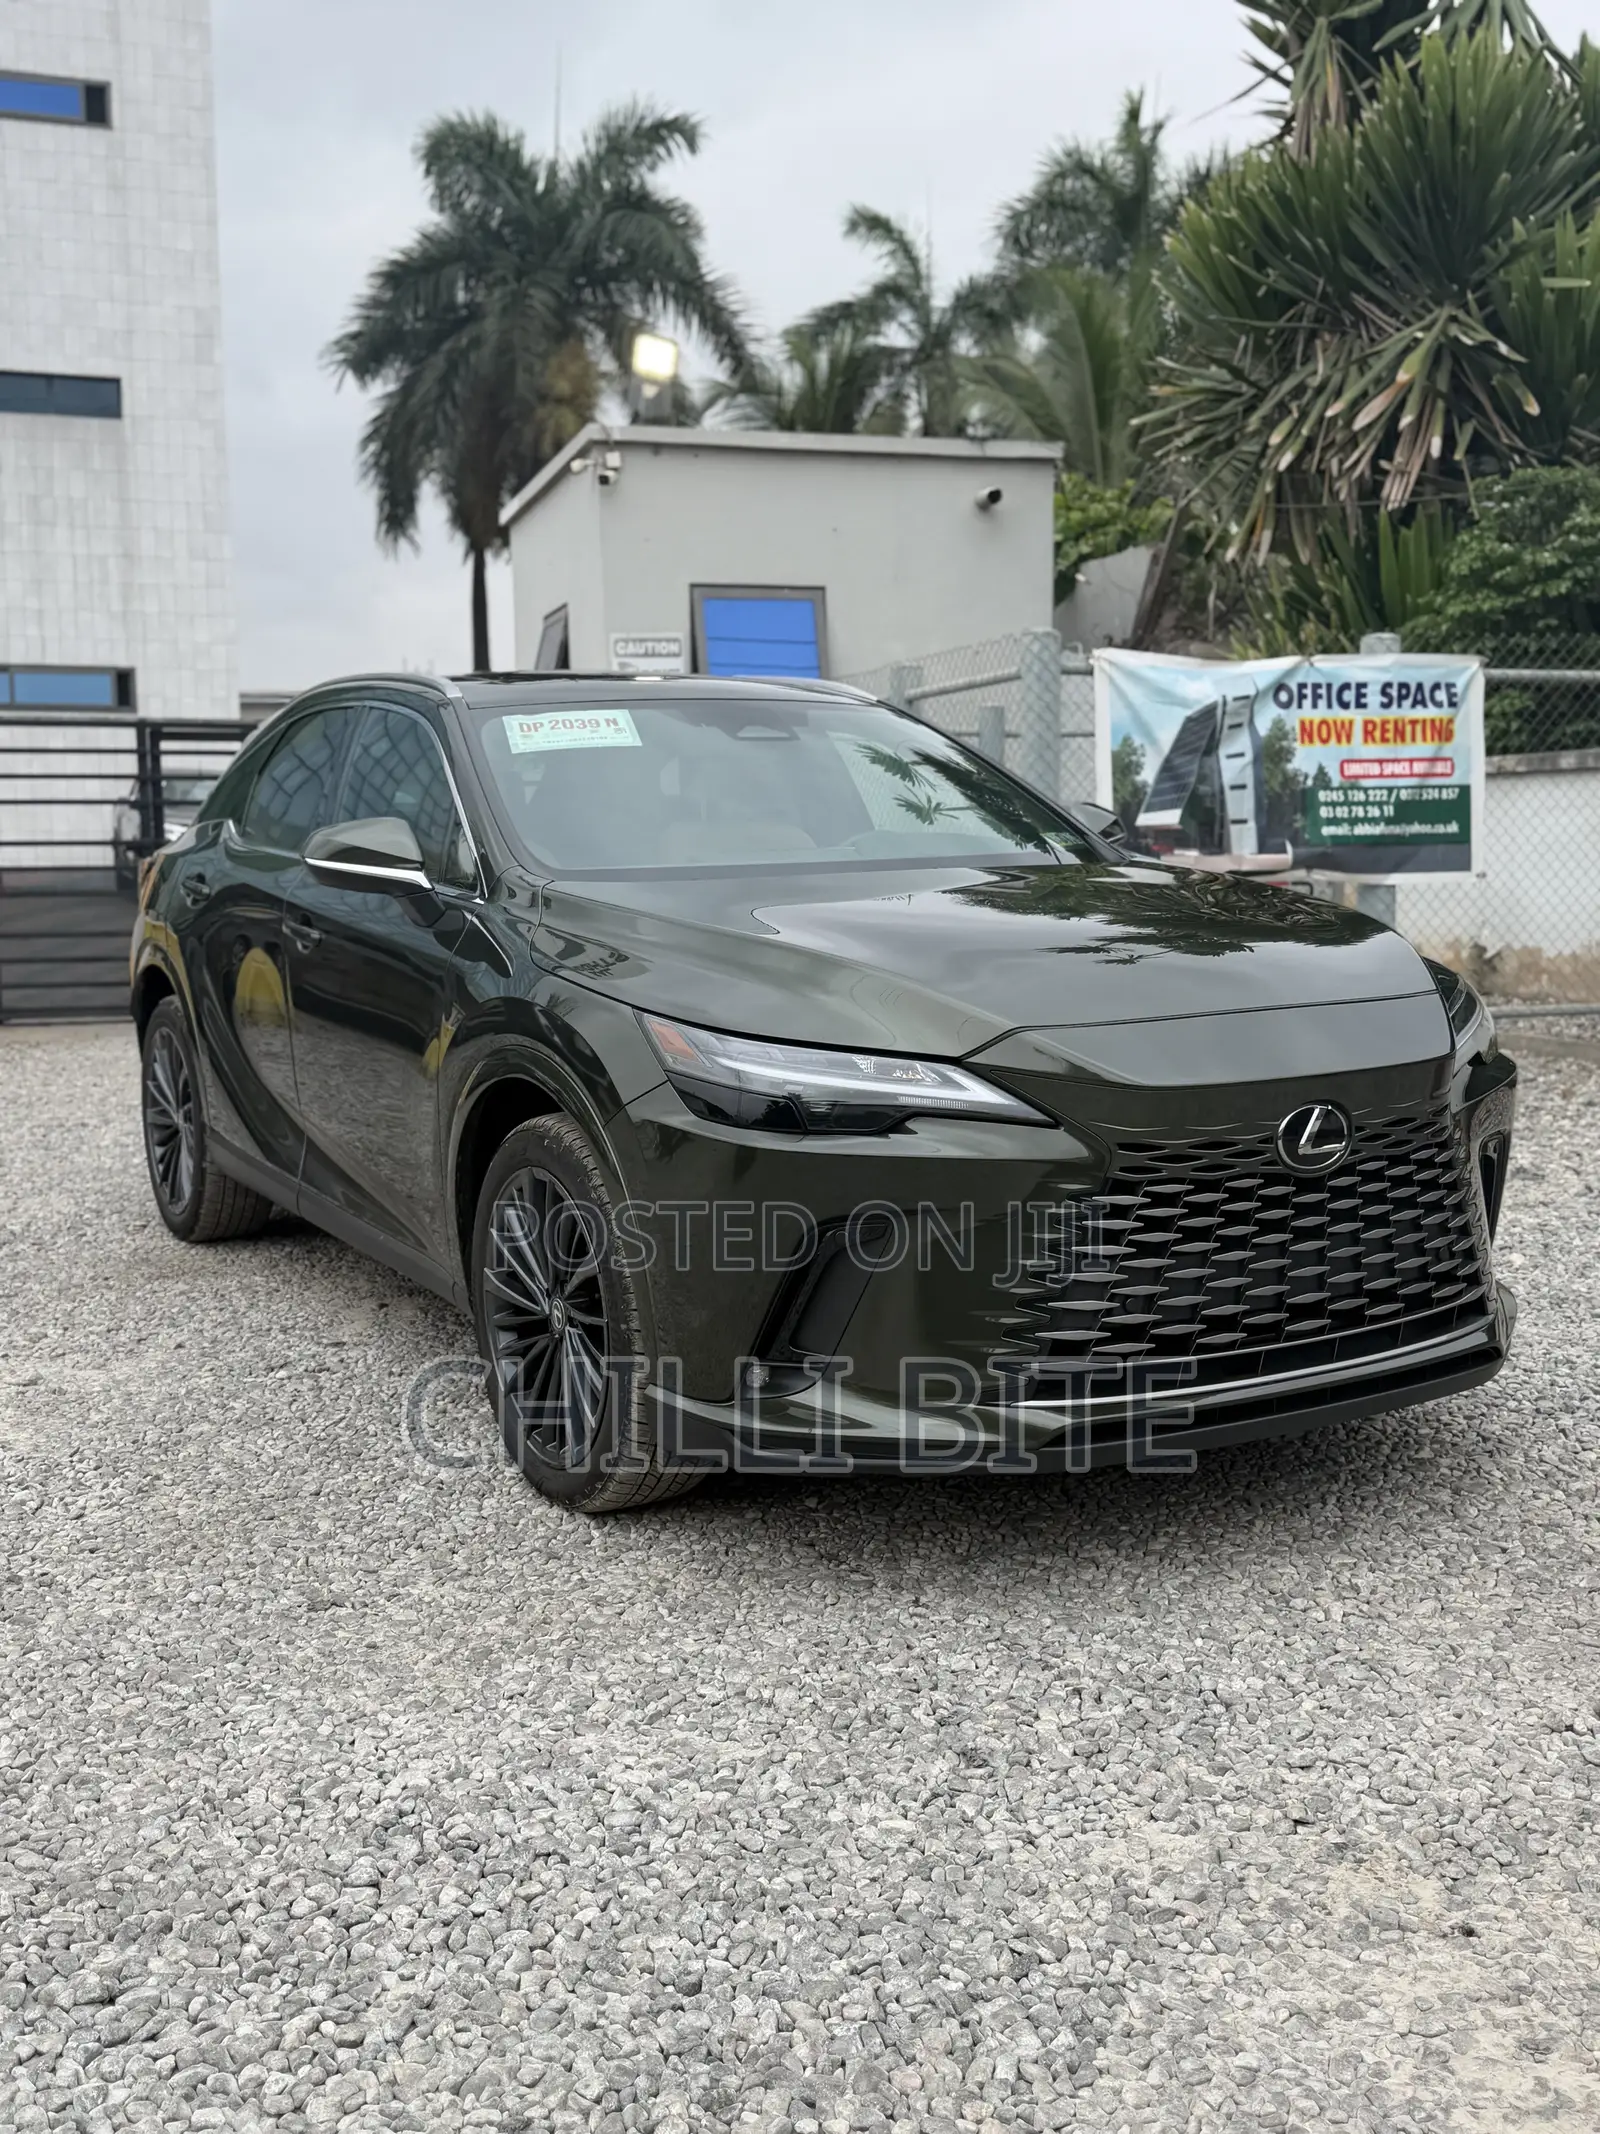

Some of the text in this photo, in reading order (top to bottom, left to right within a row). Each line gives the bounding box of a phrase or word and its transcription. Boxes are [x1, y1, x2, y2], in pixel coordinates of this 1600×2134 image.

[615, 640, 680, 655] CAUTION
[1272, 681, 1458, 710] OFFICE SPACE
[518, 717, 619, 734] DP 2039 N
[1298, 716, 1456, 745] NOW RENTING
[1382, 761, 1411, 775] SPACE
